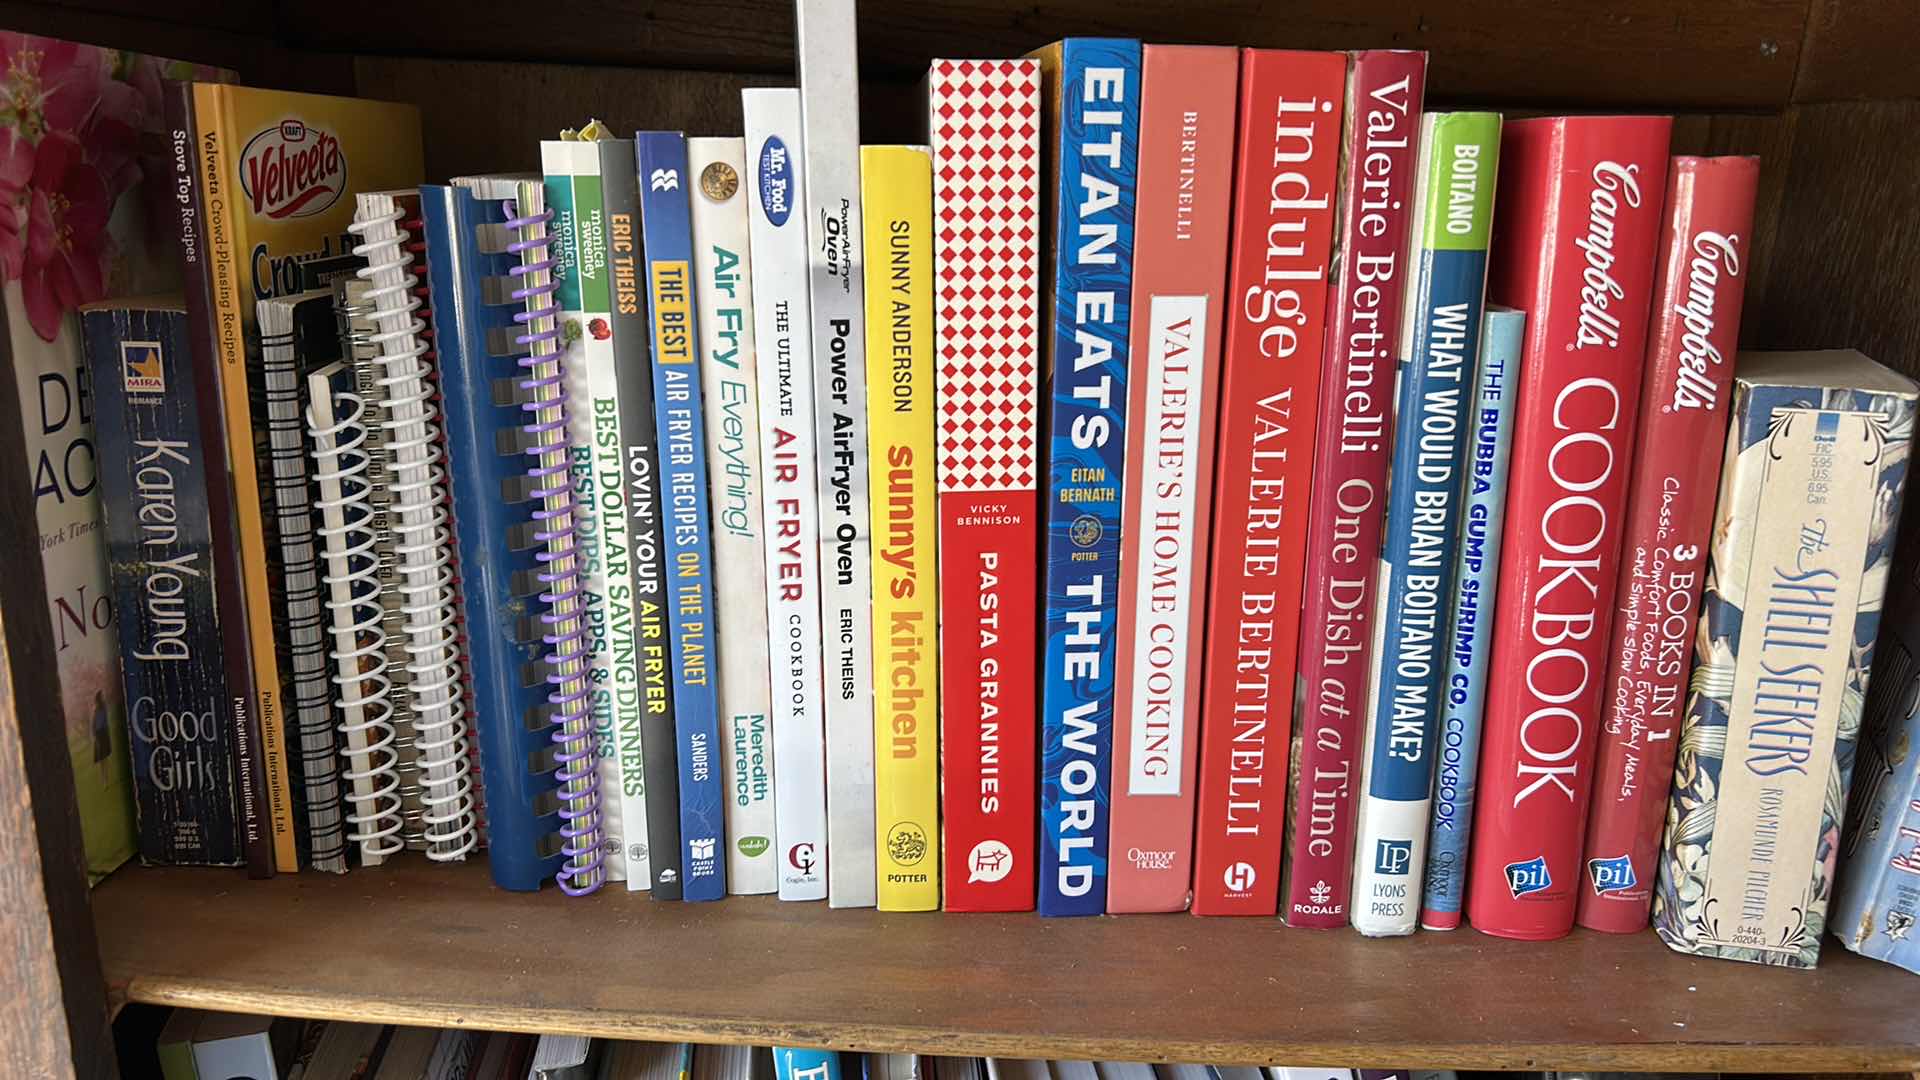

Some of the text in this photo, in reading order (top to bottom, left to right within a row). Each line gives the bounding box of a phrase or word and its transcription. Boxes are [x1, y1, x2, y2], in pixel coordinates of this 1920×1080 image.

[172, 129, 197, 264] Stove Top Recipes
[248, 131, 339, 215] Velveeta
[762, 153, 772, 211] TEST KITCHEN
[769, 146, 788, 214] Mr. Food
[1176, 111, 1199, 241] BERTINELLI
[1446, 144, 1481, 235] BOITANO
[203, 131, 237, 365] Velveeta Crowd-Pleasing Recipes
[552, 221, 568, 282] sweeney
[560, 210, 578, 269] monica
[581, 221, 596, 280] sweeney
[590, 208, 607, 268] monica
[611, 213, 638, 315] ERIC THEISS
[825, 216, 841, 277] Oven
[1070, 67, 1126, 450] EITAN EATS
[1244, 95, 1333, 359] indulge
[1340, 75, 1411, 455] Valerie Bertinelli
[1574, 159, 1641, 350] Campbell's
[889, 220, 913, 413] SUNNY ANDERSON
[1672, 230, 1740, 413] Campbell's
[127, 378, 161, 387] MIRA
[712, 244, 755, 539] Air Fry Everything!
[1481, 358, 1505, 401] THE
[134, 438, 190, 546] Karen
[569, 444, 595, 511] BEST
[658, 266, 707, 687] THE BEST AIR FRYER RECIPES ON THE PLANET
[1060, 487, 1115, 503] BERNATH
[1071, 467, 1105, 482] EITAN
[1471, 408, 1500, 496] BUBBA
[576, 513, 600, 581] DIPS,
[773, 300, 805, 717] THE ULTIMATE AIR FRYER COOKBOOK
[828, 318, 857, 701] Power AirFryer Oven ERIC THEISS
[956, 515, 1021, 526] BENNISON
[970, 504, 1008, 514] VICKY
[1143, 316, 1193, 777] VALERIE'S HOME COOKING
[1389, 302, 1469, 762] WHAT WOULD BRIAN BOITANO MAKE?
[1462, 503, 1489, 573] GUMP
[593, 397, 645, 798] BEST DOLLAR SAVING DINNERS
[627, 445, 667, 714] LOVIN' YOUR AIR FRYER
[1071, 552, 1099, 561] POTTER
[1513, 376, 1620, 808] COOKBOOK
[133, 552, 201, 661] Young
[880, 445, 925, 760] sunny's kitchen
[1226, 387, 1293, 837] VALERIE BERTINELLI
[1453, 578, 1480, 668] SHRIMP
[1604, 546, 1650, 735] and simple slow Cooking
[1616, 476, 1680, 802] Classic Comfort Foods, Everyday Meals,
[1647, 543, 1698, 742] 3 BOOKS IN 1
[587, 667, 609, 685] &
[979, 552, 1000, 814] PASTA GRANNIES
[1307, 478, 1375, 857] One Dish at a Time
[1448, 673, 1470, 710] CO.
[1743, 566, 1841, 778] SHELL SEEKERS
[131, 696, 218, 744] Good
[262, 690, 287, 837] Publications International, Ltd.
[591, 688, 615, 759] SIDES
[690, 733, 709, 783] SANDERS
[733, 715, 751, 807] Laurence
[748, 714, 769, 802] Meredith
[1057, 575, 1103, 898] THE WORLD
[148, 744, 217, 793] Girls
[235, 696, 259, 845] Publications International, Ltd.
[1435, 718, 1465, 831] COOKBOOK
[887, 873, 928, 884] POTTER
[1127, 847, 1176, 862] Oxmoor
[1372, 883, 1407, 898] LYONS
[1511, 864, 1546, 891] pil
[1595, 862, 1632, 888] pil
[1741, 787, 1784, 921] ROSAMUNDE PILCHER
[1293, 903, 1344, 915] RODALE
[1370, 902, 1405, 917] PRESS
[1731, 934, 1767, 945] 20204-3
[1737, 925, 1765, 936] 0-440-
